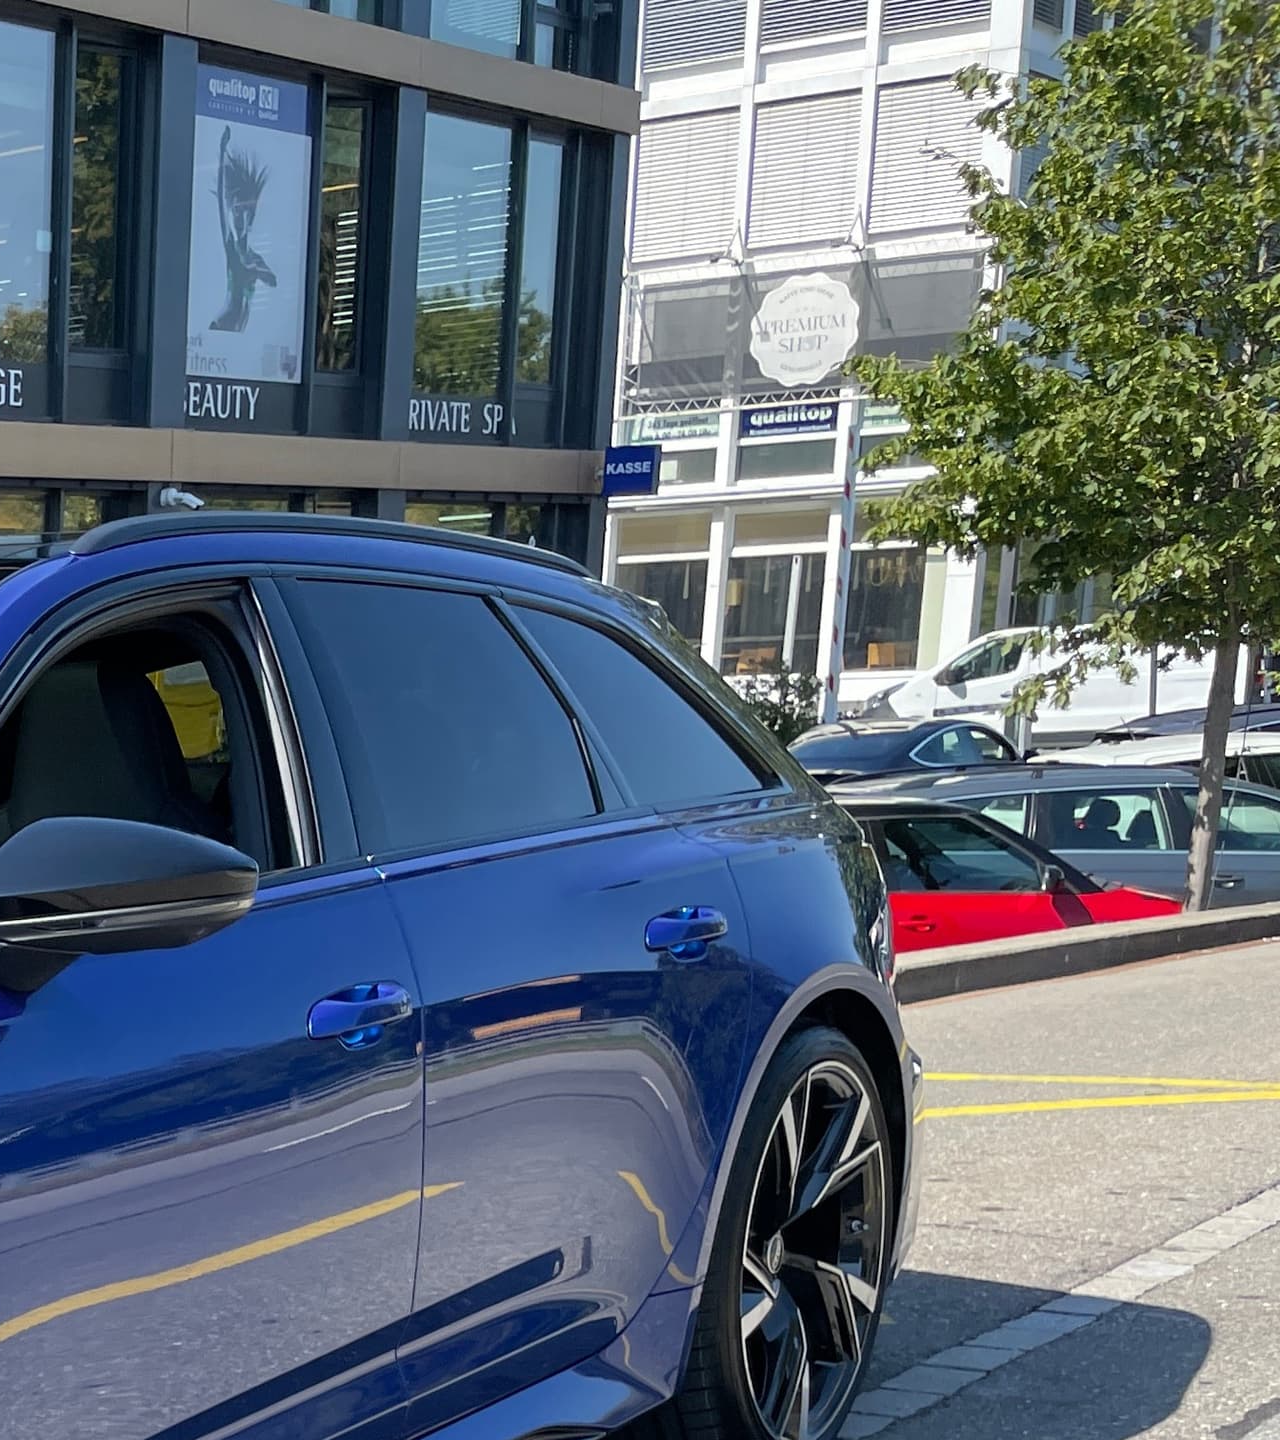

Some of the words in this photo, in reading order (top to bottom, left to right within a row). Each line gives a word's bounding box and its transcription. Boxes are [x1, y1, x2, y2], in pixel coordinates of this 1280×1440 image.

[208, 78, 257, 105] qualitop
[762, 313, 846, 335] PREMIUM
[187, 349, 228, 373] itness
[183, 382, 260, 420] EAUTY
[750, 405, 833, 428] qualitop
[605, 460, 652, 476] KASSE
